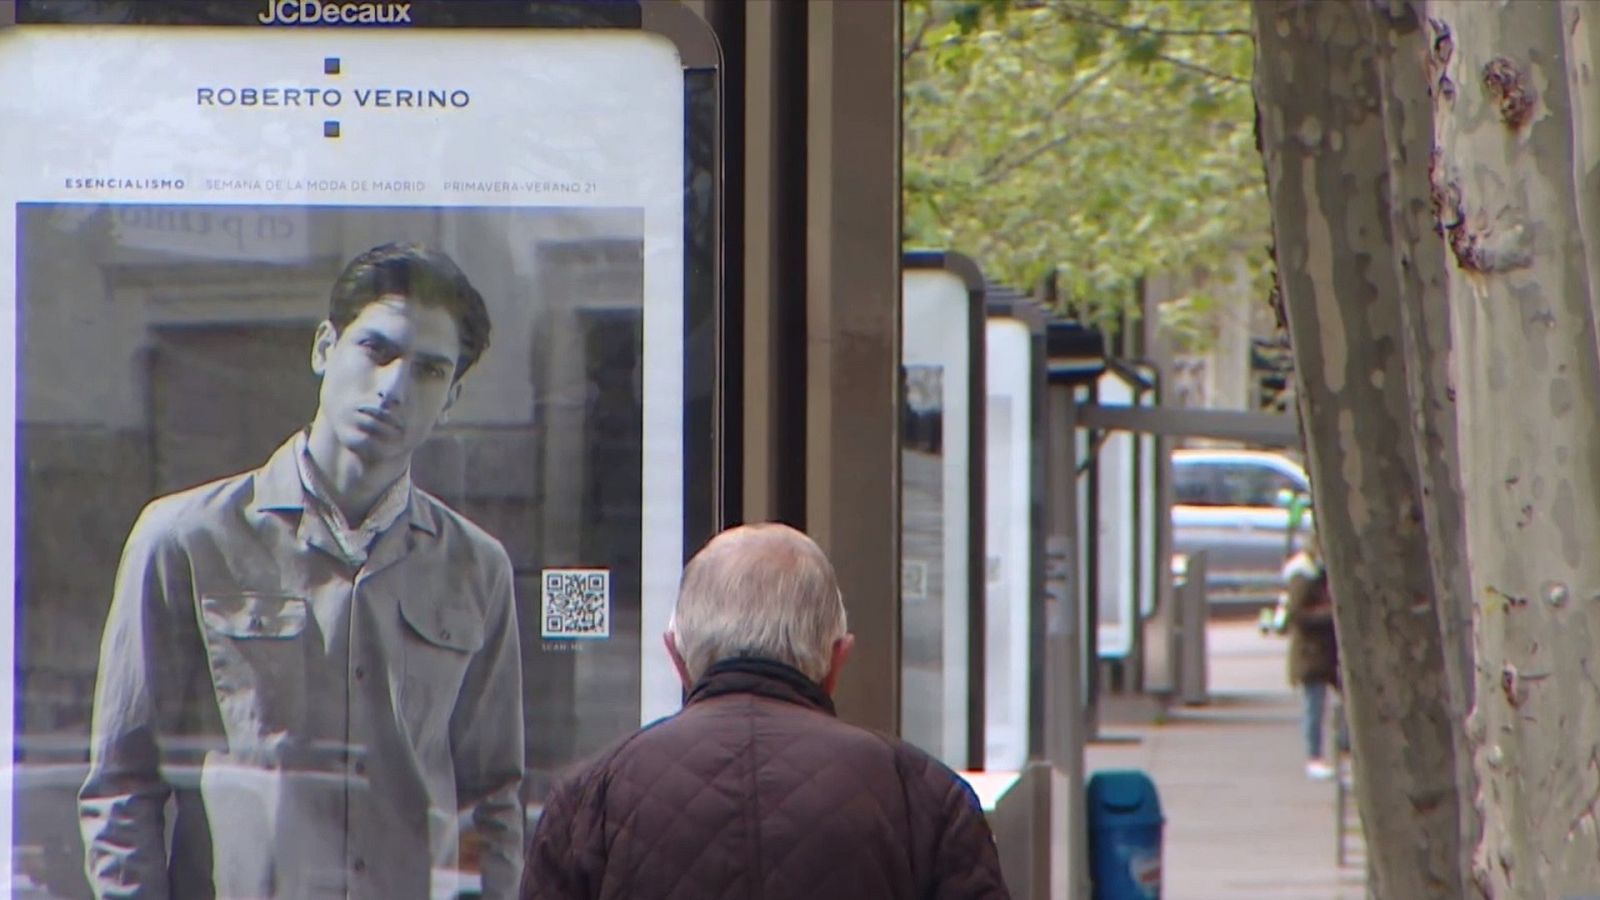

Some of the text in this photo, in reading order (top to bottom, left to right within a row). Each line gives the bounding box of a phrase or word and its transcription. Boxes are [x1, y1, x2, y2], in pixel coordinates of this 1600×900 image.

[258, 0, 411, 24] JCDecaux
[197, 88, 470, 108] ROBERTO VERINO
[65, 179, 597, 193] ESENCIALISMO SEMANA DE LA MODA DE MADRID PRIMAVERA-VERANO 21
